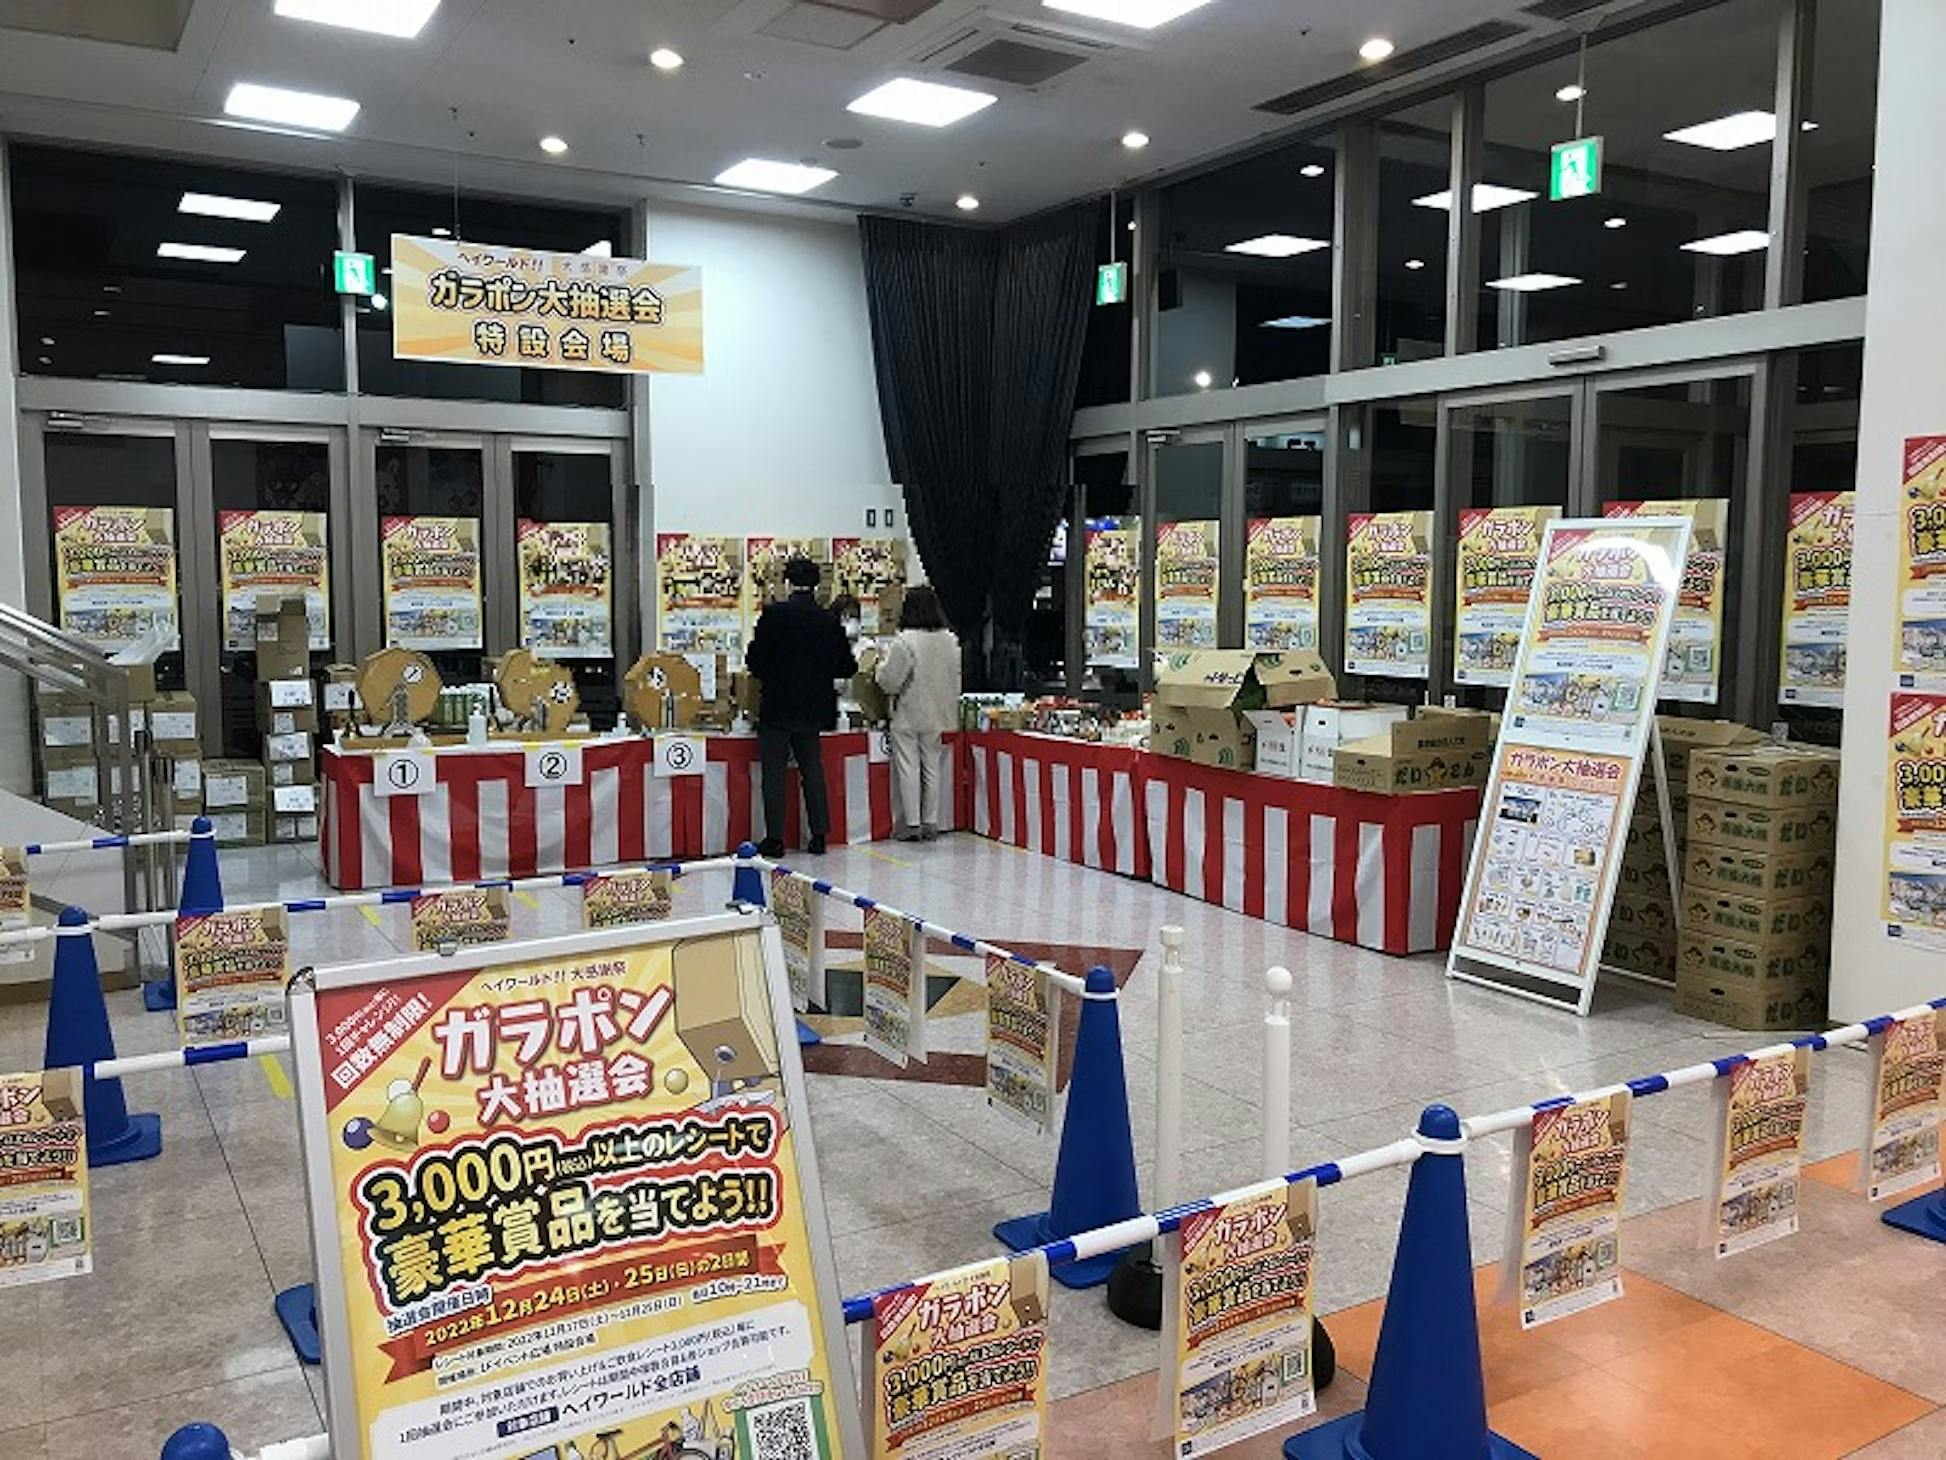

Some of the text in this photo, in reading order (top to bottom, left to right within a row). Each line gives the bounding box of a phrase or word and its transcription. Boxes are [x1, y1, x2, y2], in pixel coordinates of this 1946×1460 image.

[430, 270, 664, 324] ガラポン大抽選会
[474, 322, 632, 364] 特設会場
[1508, 752, 1623, 780] ガラポン大抽選会
[330, 991, 433, 1091] 回数無制限!
[434, 984, 673, 1078] ガラポン
[478, 1052, 652, 1125] 大抽選会
[386, 1172, 769, 1299] 豪華賞品を当てよう!!
[1214, 1203, 1287, 1246] ガラポン
[918, 1280, 1011, 1332] ガラポン
